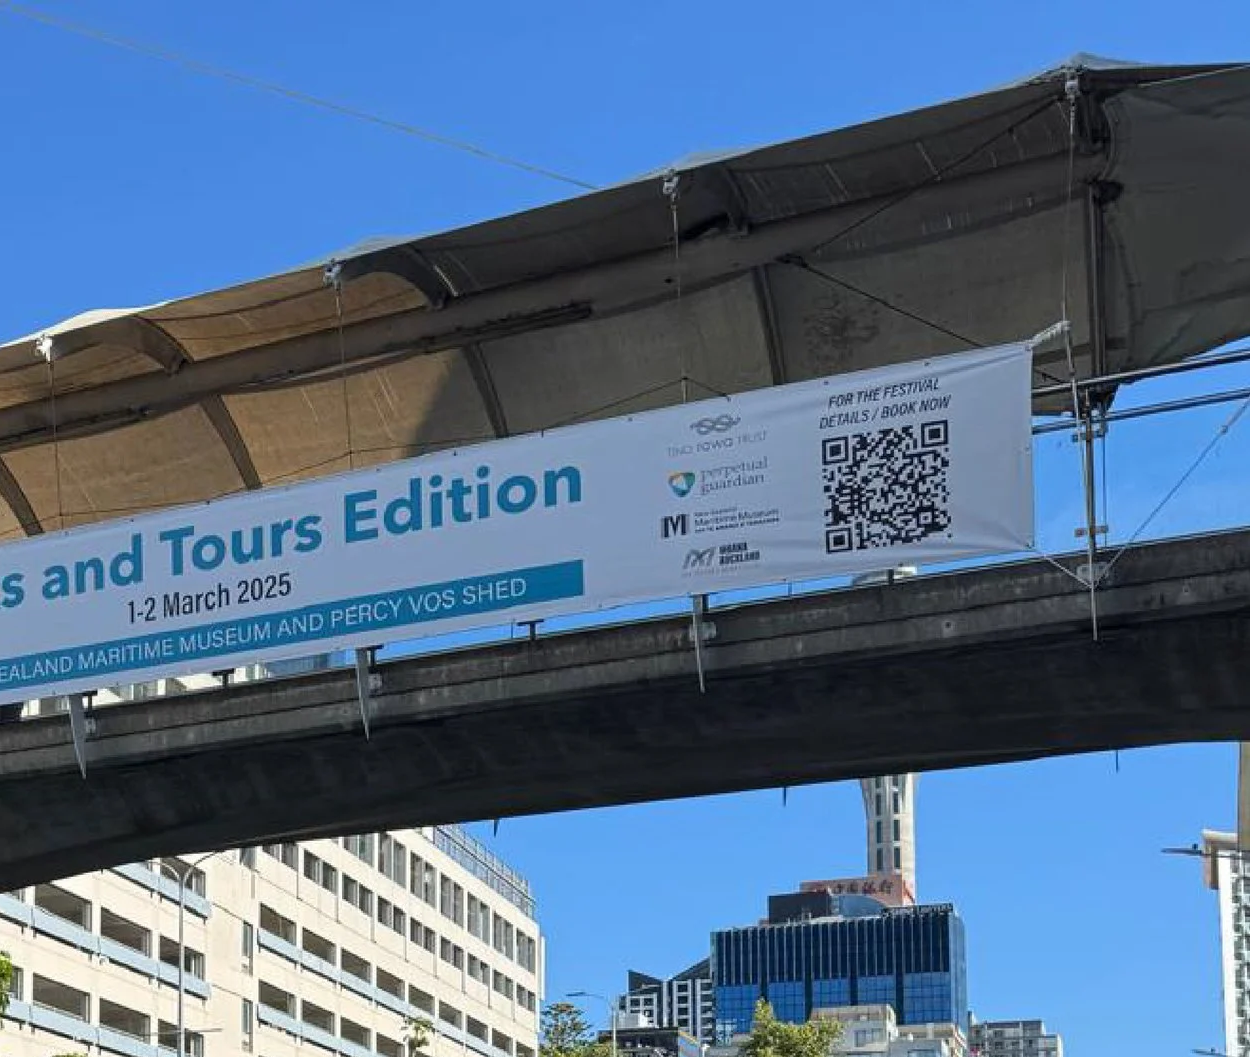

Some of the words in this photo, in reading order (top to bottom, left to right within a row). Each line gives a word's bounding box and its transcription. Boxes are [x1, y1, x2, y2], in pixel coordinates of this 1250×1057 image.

[828, 393, 853, 409] FOR
[857, 388, 881, 403] THE
[883, 377, 939, 400] FESTIVAL
[819, 409, 870, 430] DETAILS
[881, 400, 916, 419] BOOK
[918, 394, 952, 412] NOW
[701, 455, 768, 483] perpetual
[701, 474, 765, 496] guardian
[42, 531, 145, 598] and
[158, 514, 323, 577] Tours
[345, 464, 582, 544] Edition
[128, 597, 158, 624] 1-2
[163, 581, 231, 619] March
[237, 573, 292, 605] 2025
[77, 639, 173, 670] MARITIME
[179, 622, 272, 655] MUSEUM
[276, 616, 325, 640] AND
[330, 600, 403, 627] PERCY
[406, 589, 456, 616] VOS
[461, 577, 528, 606] SHED
